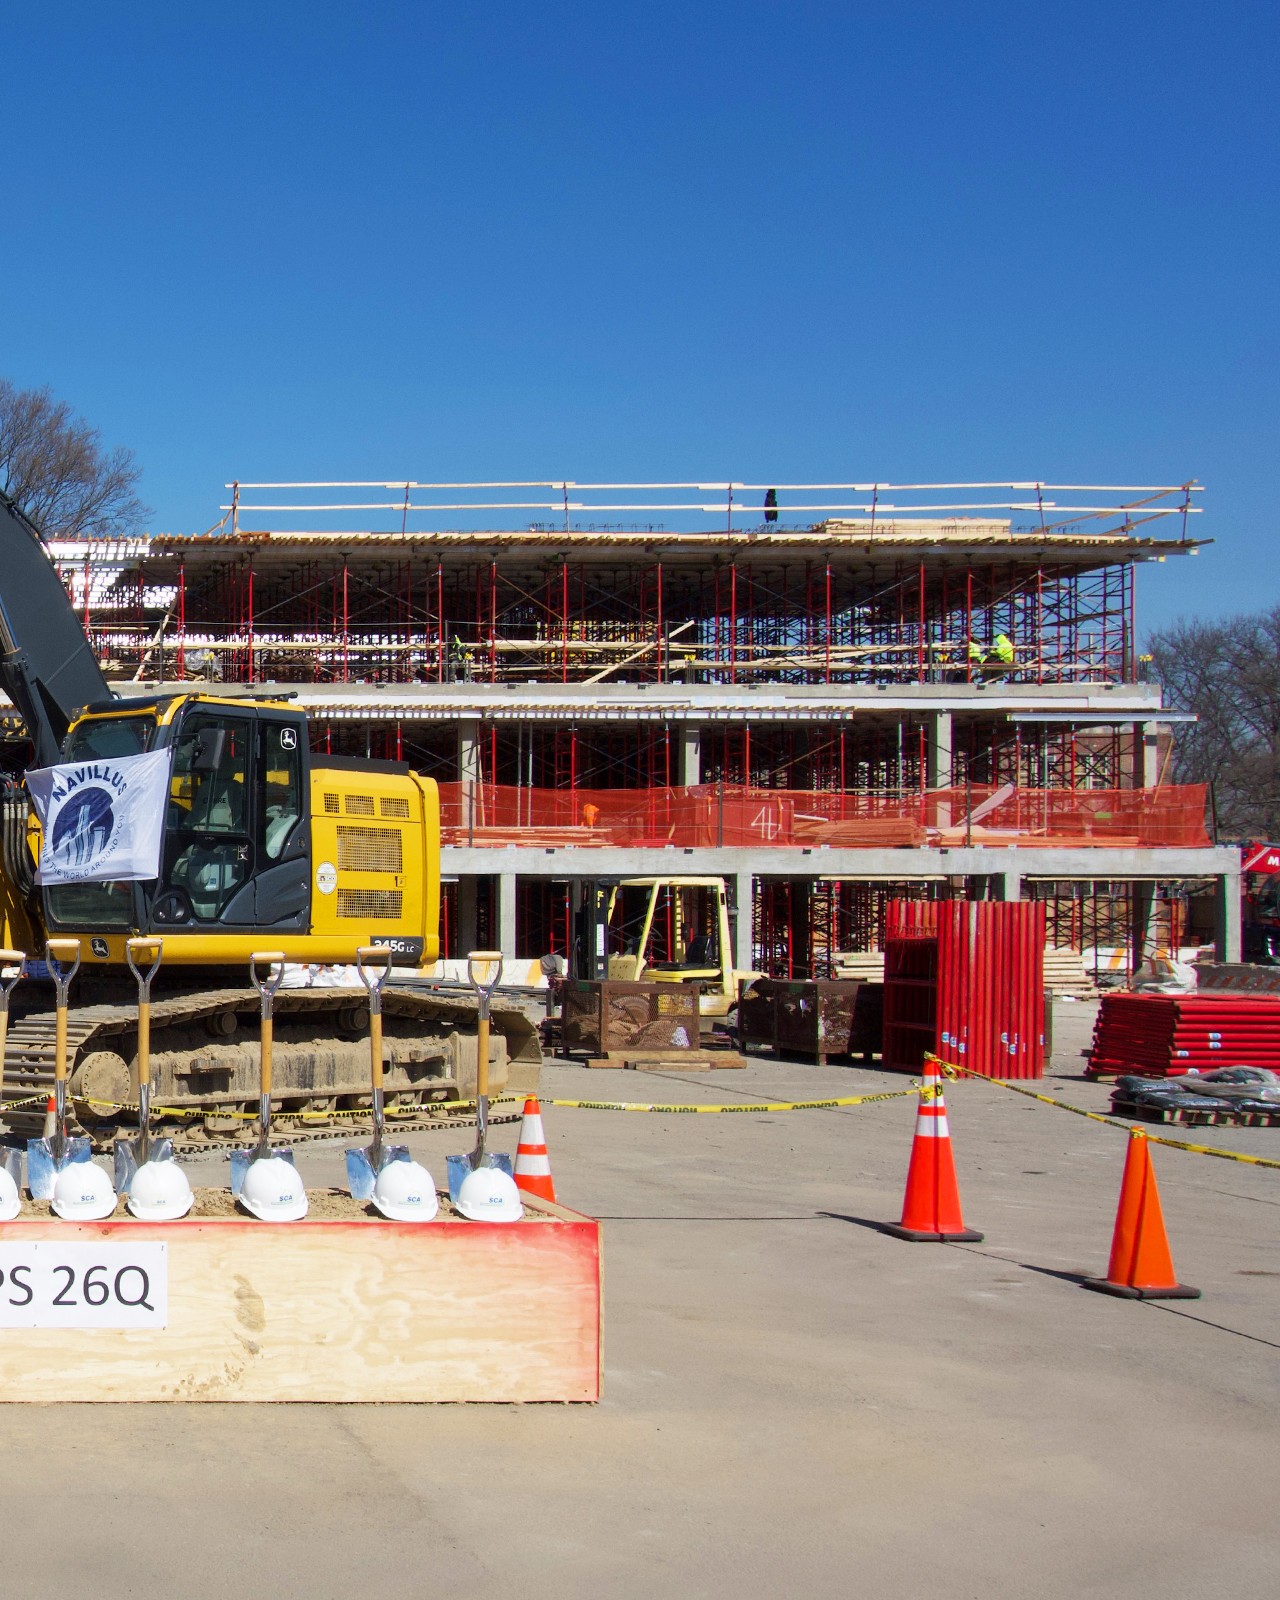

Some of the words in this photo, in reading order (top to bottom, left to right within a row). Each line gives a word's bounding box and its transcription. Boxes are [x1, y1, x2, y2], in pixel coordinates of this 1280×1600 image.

[52, 765, 127, 802] NAVILLUS
[63, 868, 89, 880] WORLD
[91, 838, 118, 872] AROUND
[52, 1265, 154, 1312] 26Q
